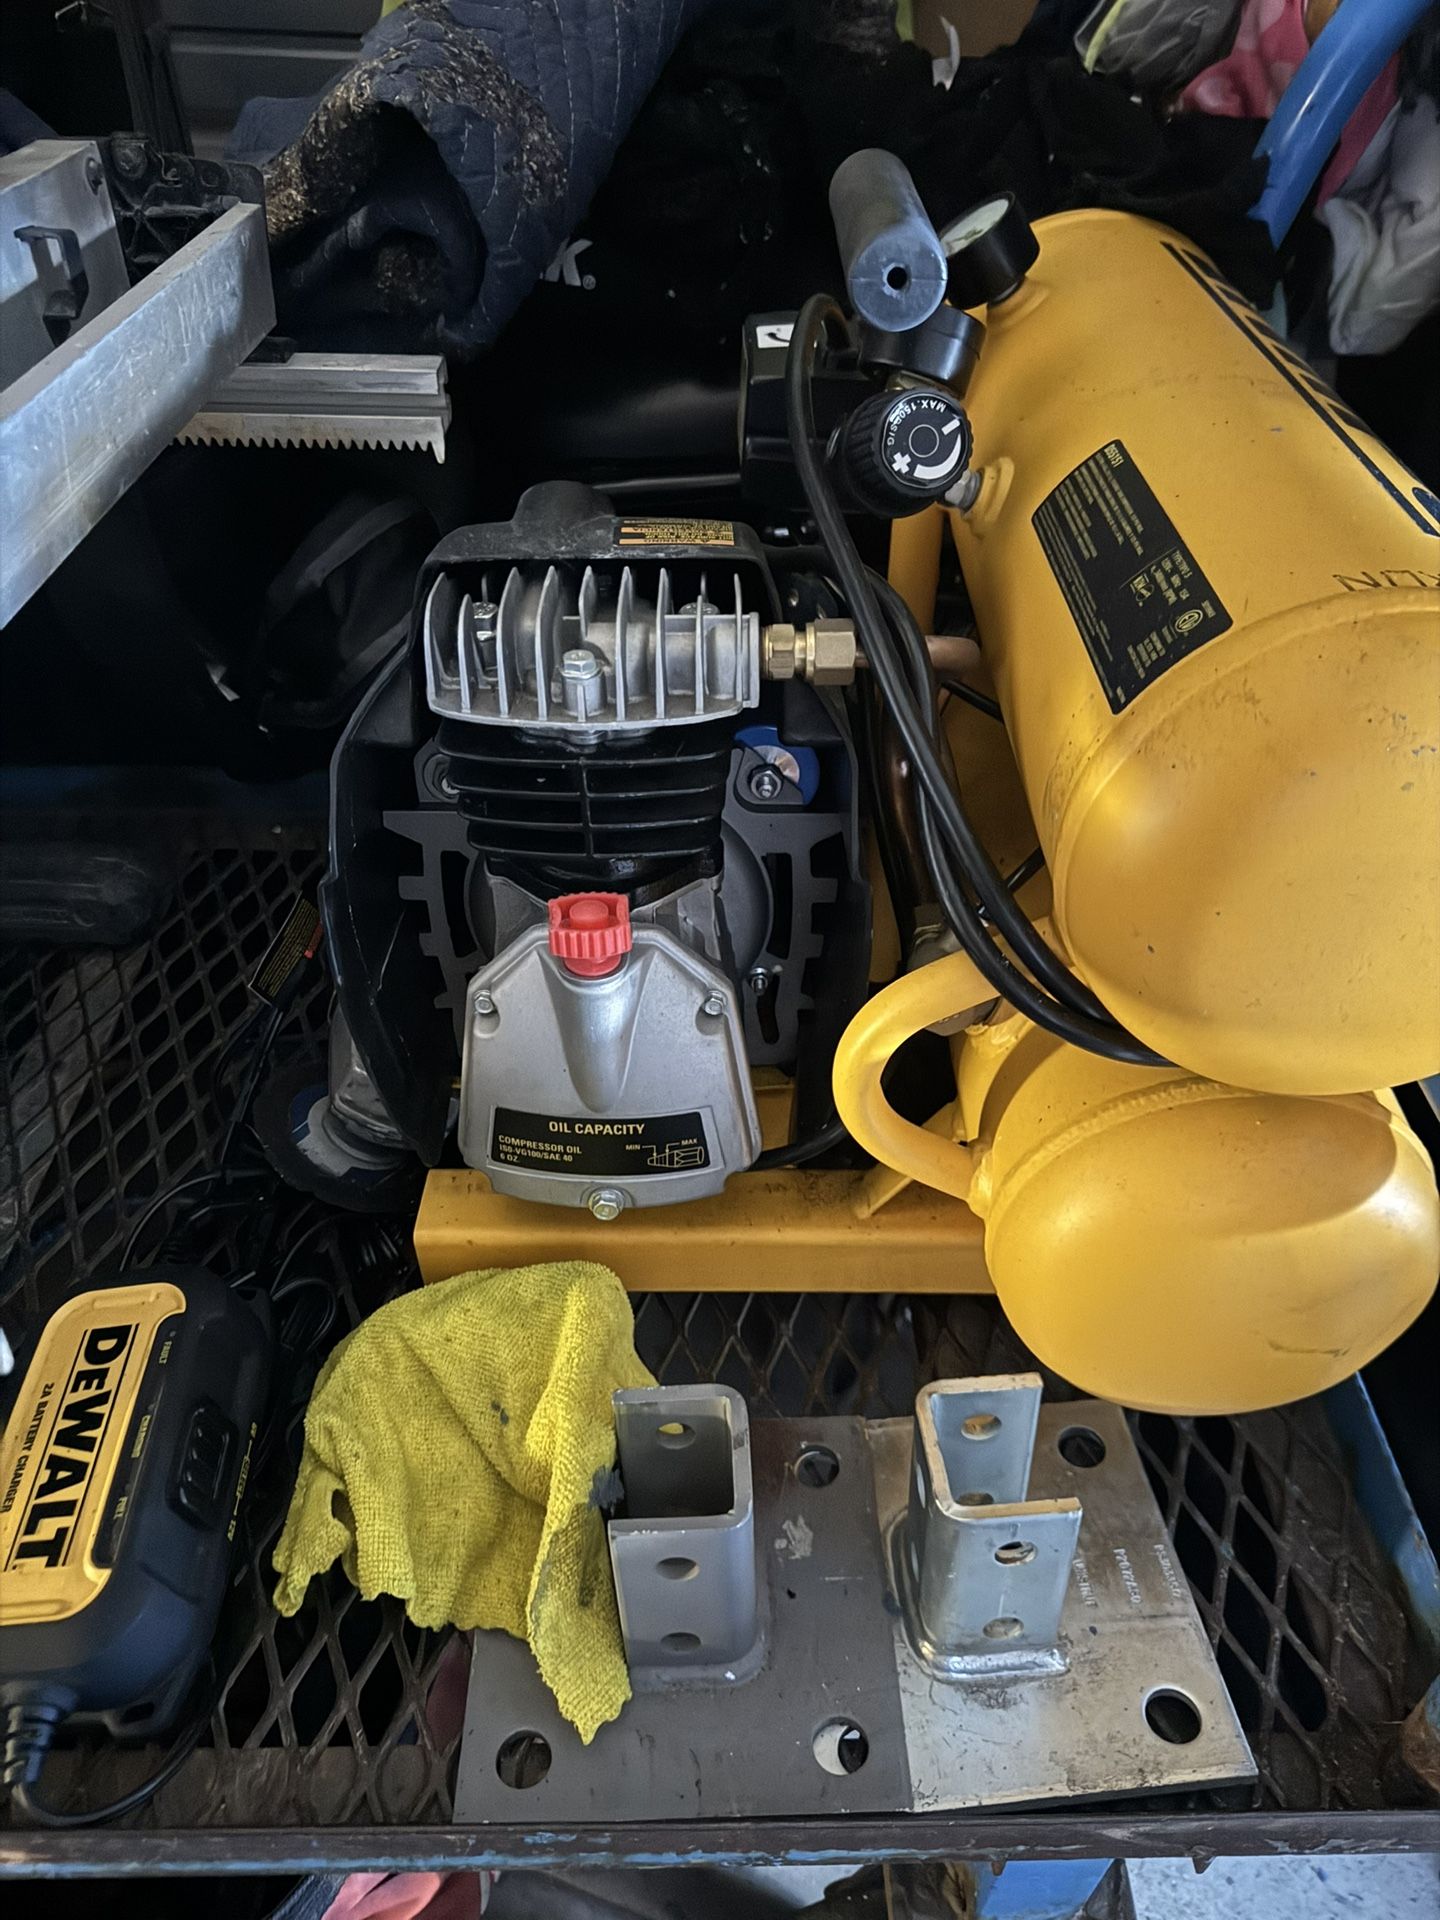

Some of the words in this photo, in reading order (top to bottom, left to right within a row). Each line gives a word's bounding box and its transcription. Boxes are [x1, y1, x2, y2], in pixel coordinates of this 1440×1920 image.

[549, 1121, 572, 1134] OIL
[574, 1123, 646, 1136] CAPACITY
[498, 1135, 564, 1154] COMPRESSOR
[566, 1145, 583, 1155] OIL
[681, 1138, 698, 1146] MAX
[562, 1154, 573, 1163] 40
[158, 1340, 172, 1365] FAULT
[39, 1382, 55, 1400] 2A
[22, 1400, 49, 1452] BATTERY
[0, 1453, 29, 1514] CHARGER
